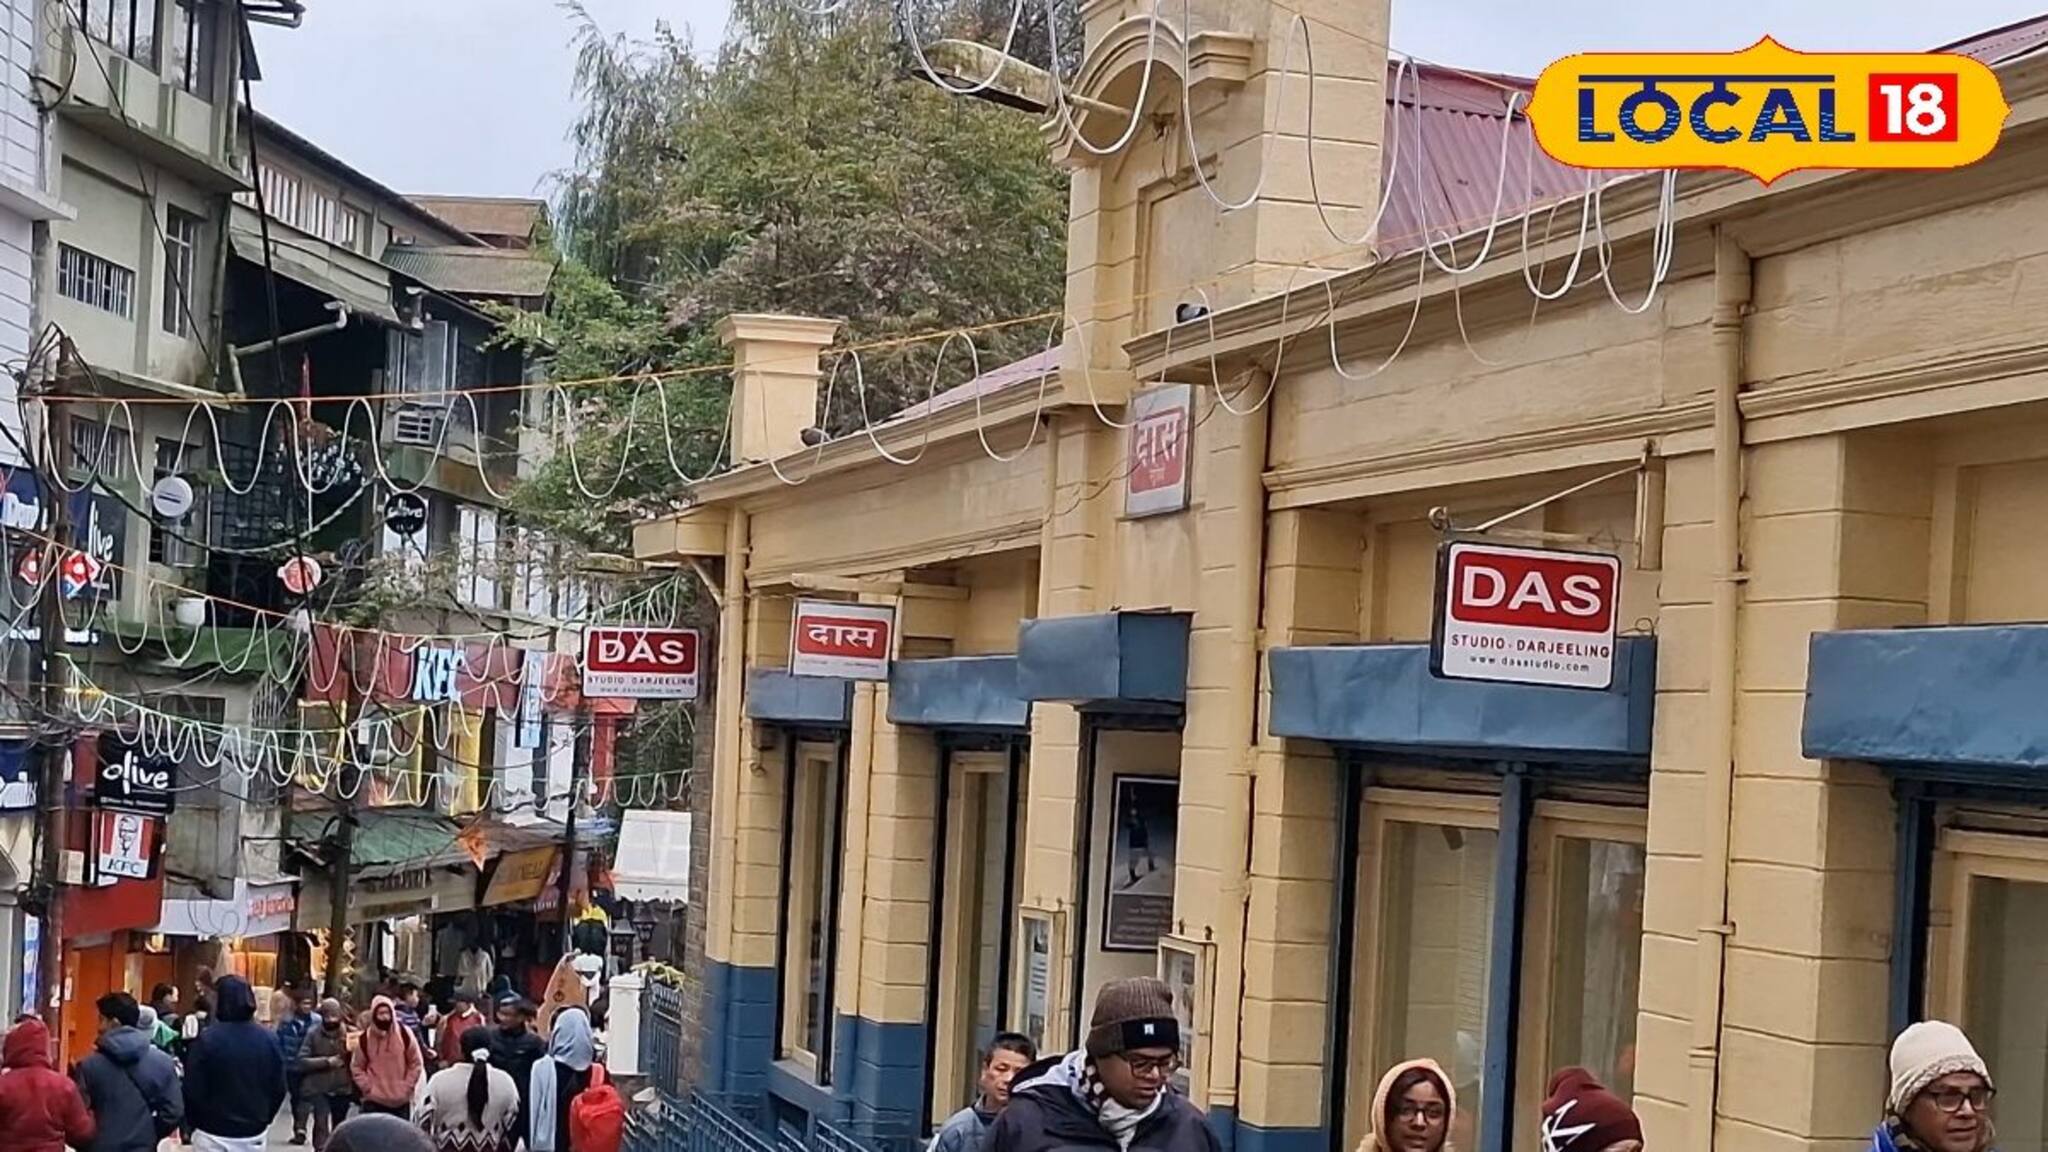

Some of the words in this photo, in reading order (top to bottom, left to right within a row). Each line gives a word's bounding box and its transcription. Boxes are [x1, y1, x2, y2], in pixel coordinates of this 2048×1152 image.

[1461, 565, 1602, 617] DAS
[806, 623, 879, 649] दास
[1451, 633, 1506, 650] STUDIO
[1516, 639, 1611, 659] DARJEELING
[598, 638, 685, 665] DAS
[588, 676, 625, 685] STUDIO
[102, 750, 169, 795] olive
[108, 858, 142, 875] KFC
